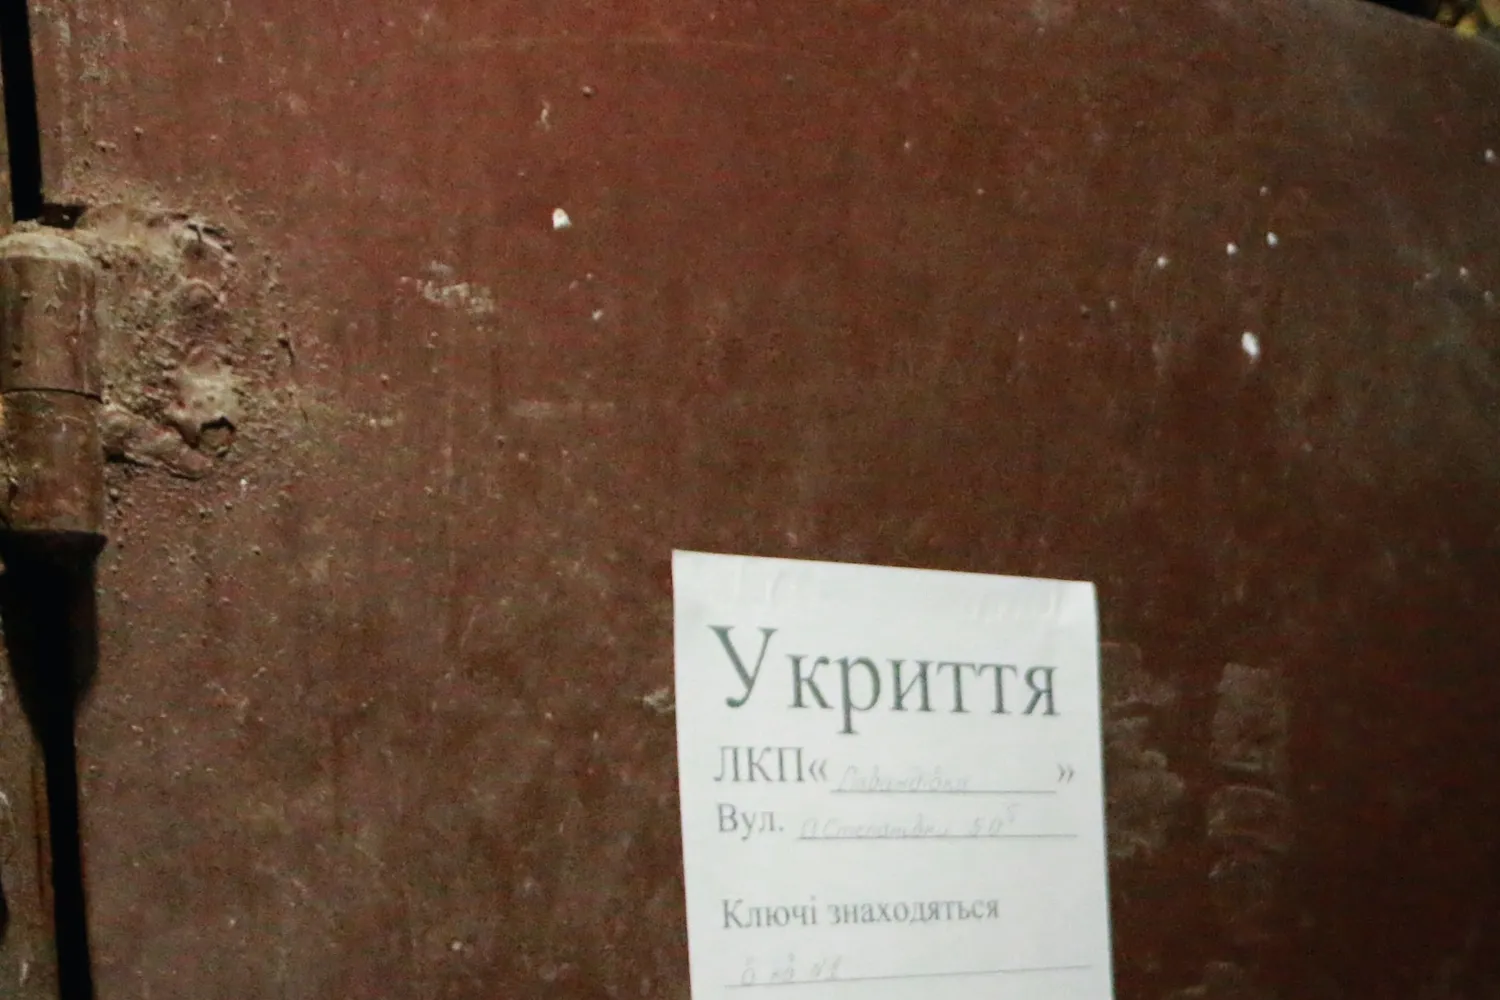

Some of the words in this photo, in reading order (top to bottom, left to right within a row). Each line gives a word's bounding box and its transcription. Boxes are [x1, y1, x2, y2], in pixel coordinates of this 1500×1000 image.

[708, 624, 1062, 735] Укриття
[716, 802, 784, 842] Вул.
[721, 896, 818, 929] Ключі
[827, 897, 1000, 927] знаходяться
